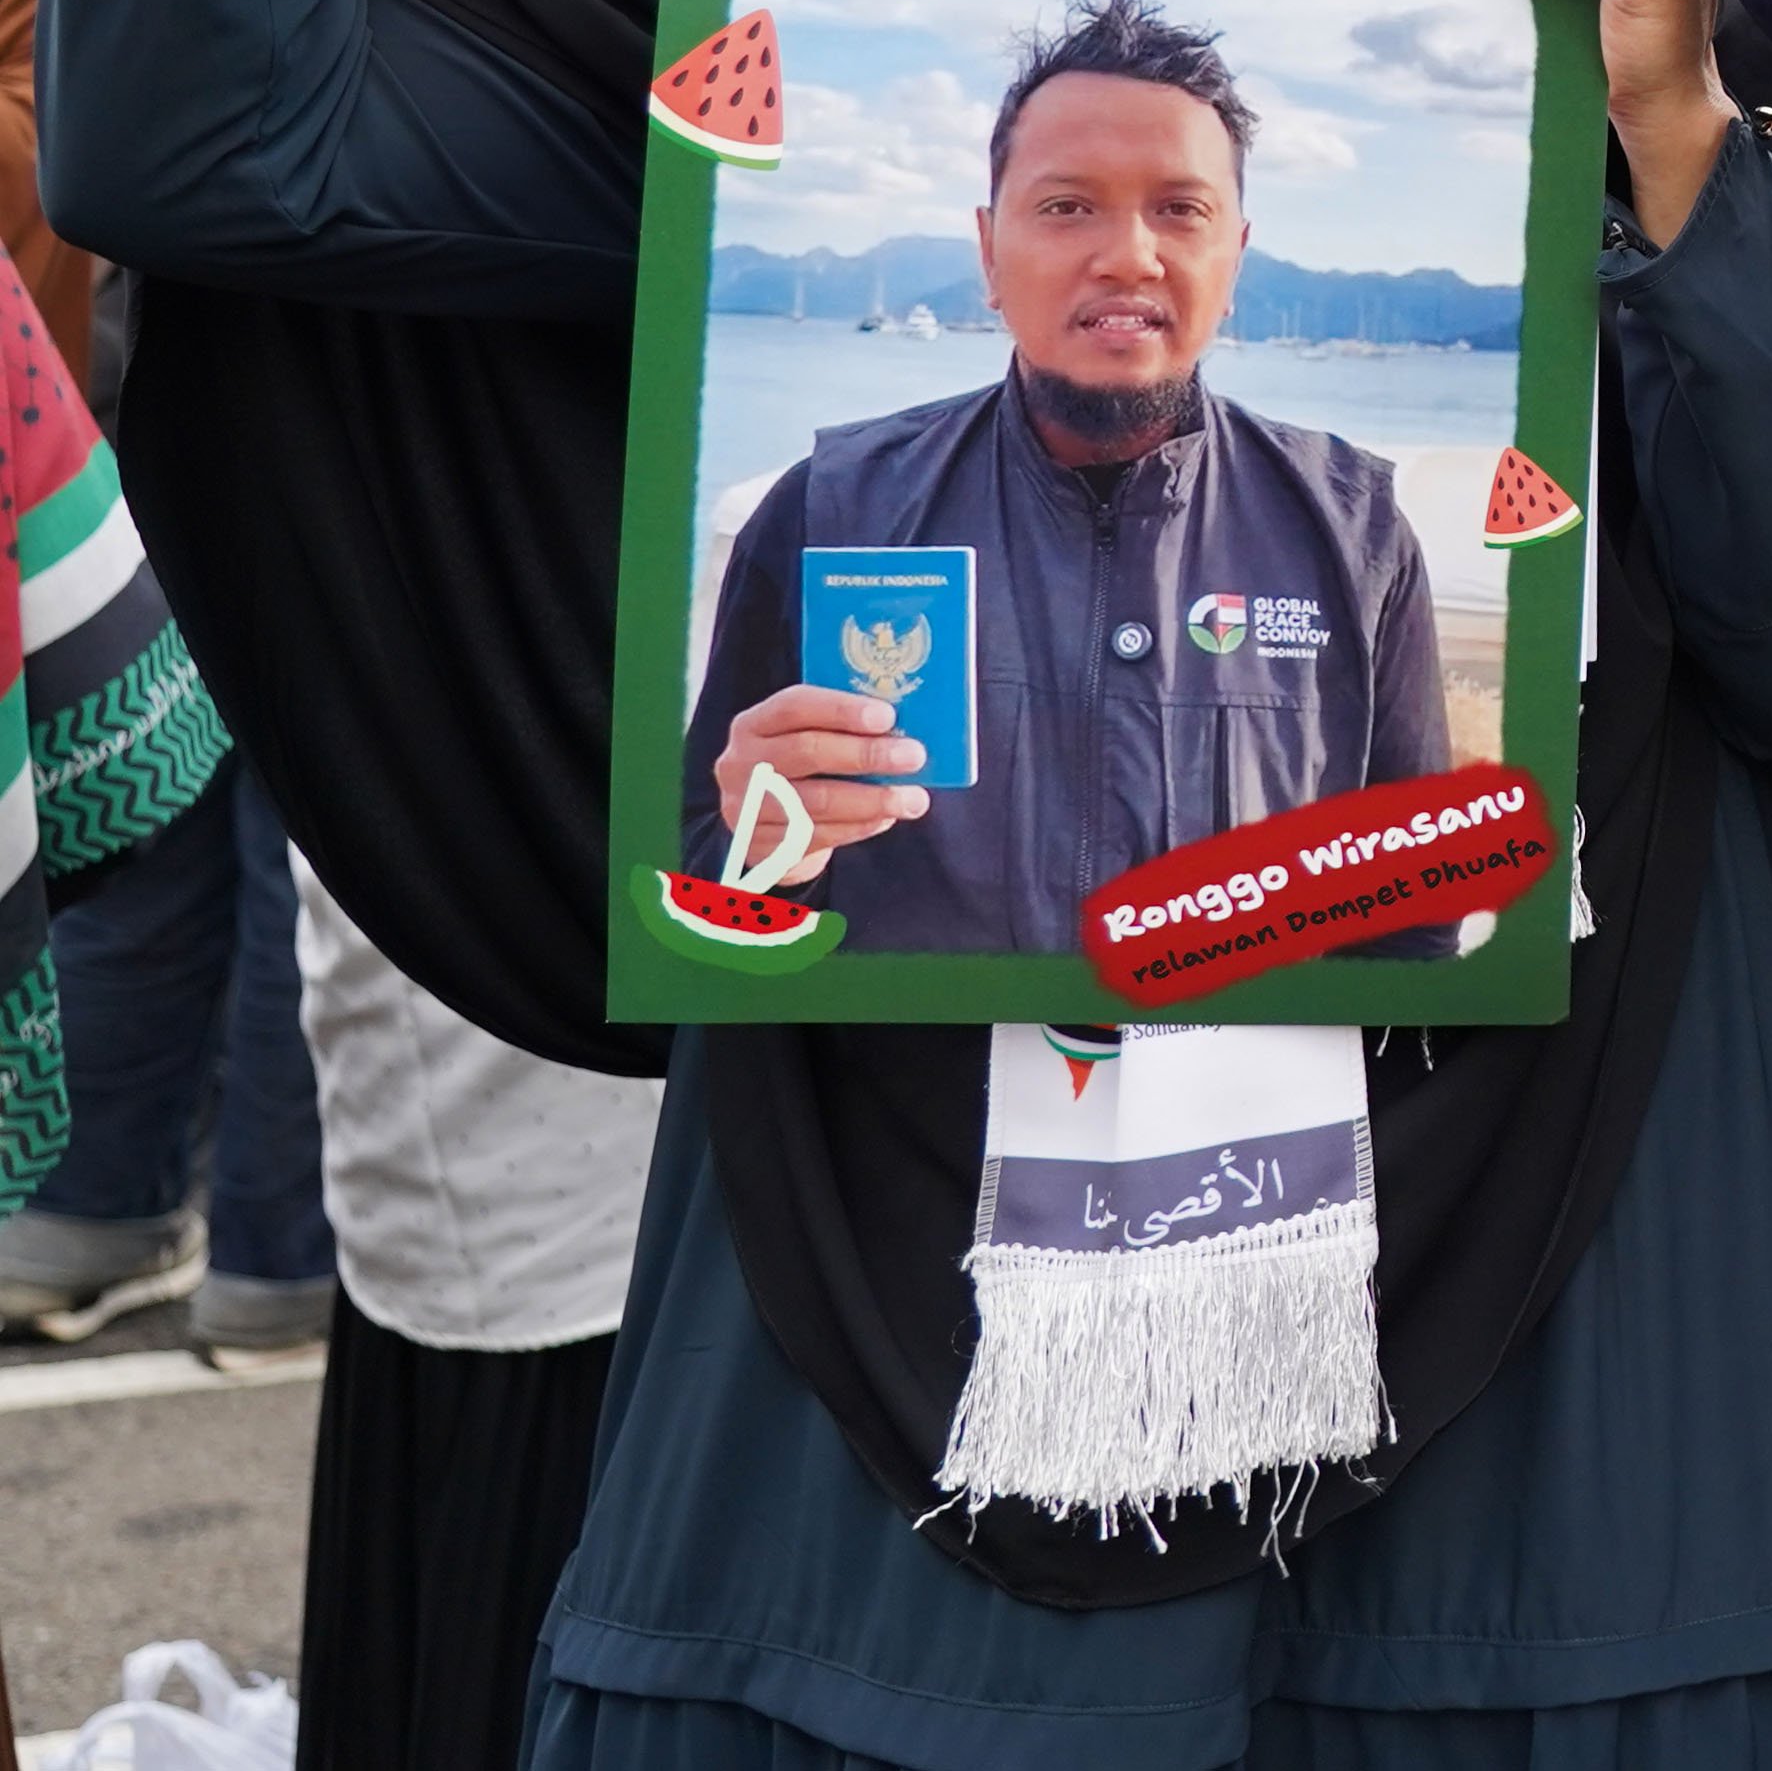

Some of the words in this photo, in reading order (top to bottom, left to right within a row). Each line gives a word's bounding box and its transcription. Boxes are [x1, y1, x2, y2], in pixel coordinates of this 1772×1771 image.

[883, 574, 949, 587] INDONESIA
[1253, 596, 1321, 615] GLOBAL
[1254, 612, 1310, 628] PEACE
[1254, 626, 1332, 645] CONVOY
[1256, 647, 1317, 659] INDONESIA
[1103, 863, 1289, 943] Ronggo
[1299, 785, 1525, 875] Wirasanu
[1131, 922, 1278, 985] relawan
[1285, 876, 1411, 933] Dompet
[1421, 838, 1546, 890] Dhuafa
